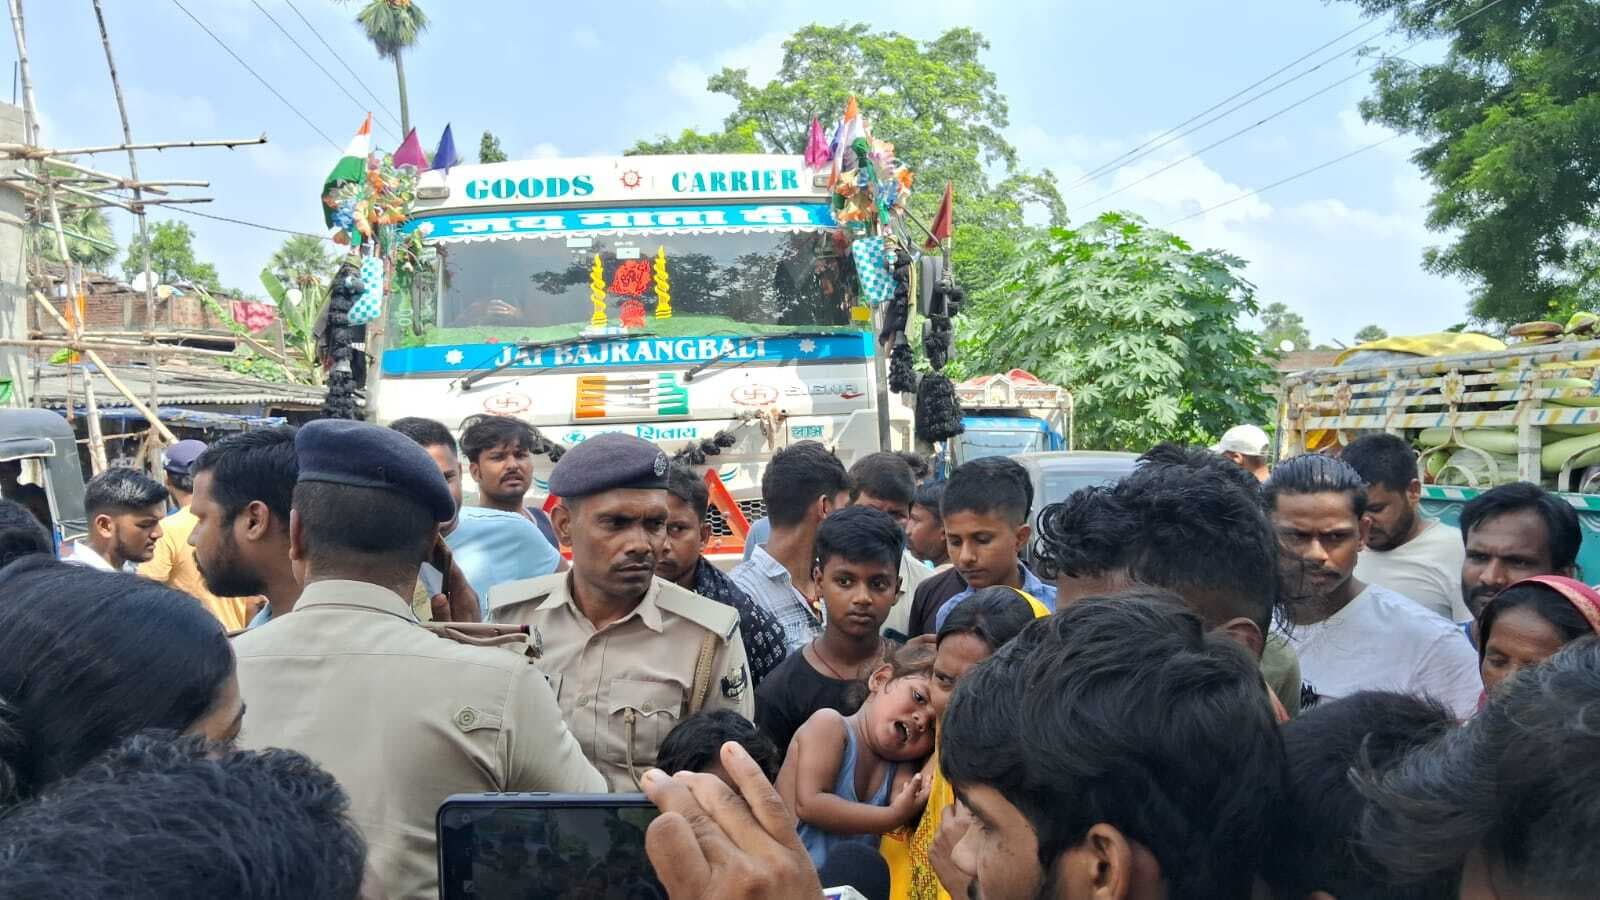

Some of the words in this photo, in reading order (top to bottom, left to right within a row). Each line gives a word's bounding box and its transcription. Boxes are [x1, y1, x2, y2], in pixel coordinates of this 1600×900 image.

[465, 175, 594, 200] GOODS
[671, 169, 800, 193] CARRIER
[449, 214, 567, 234] जय
[576, 210, 728, 229] माता
[739, 205, 813, 224] दी
[495, 345, 543, 367] JAI
[554, 338, 766, 365] BAJRANGBALI
[636, 424, 697, 440] शिवाय
